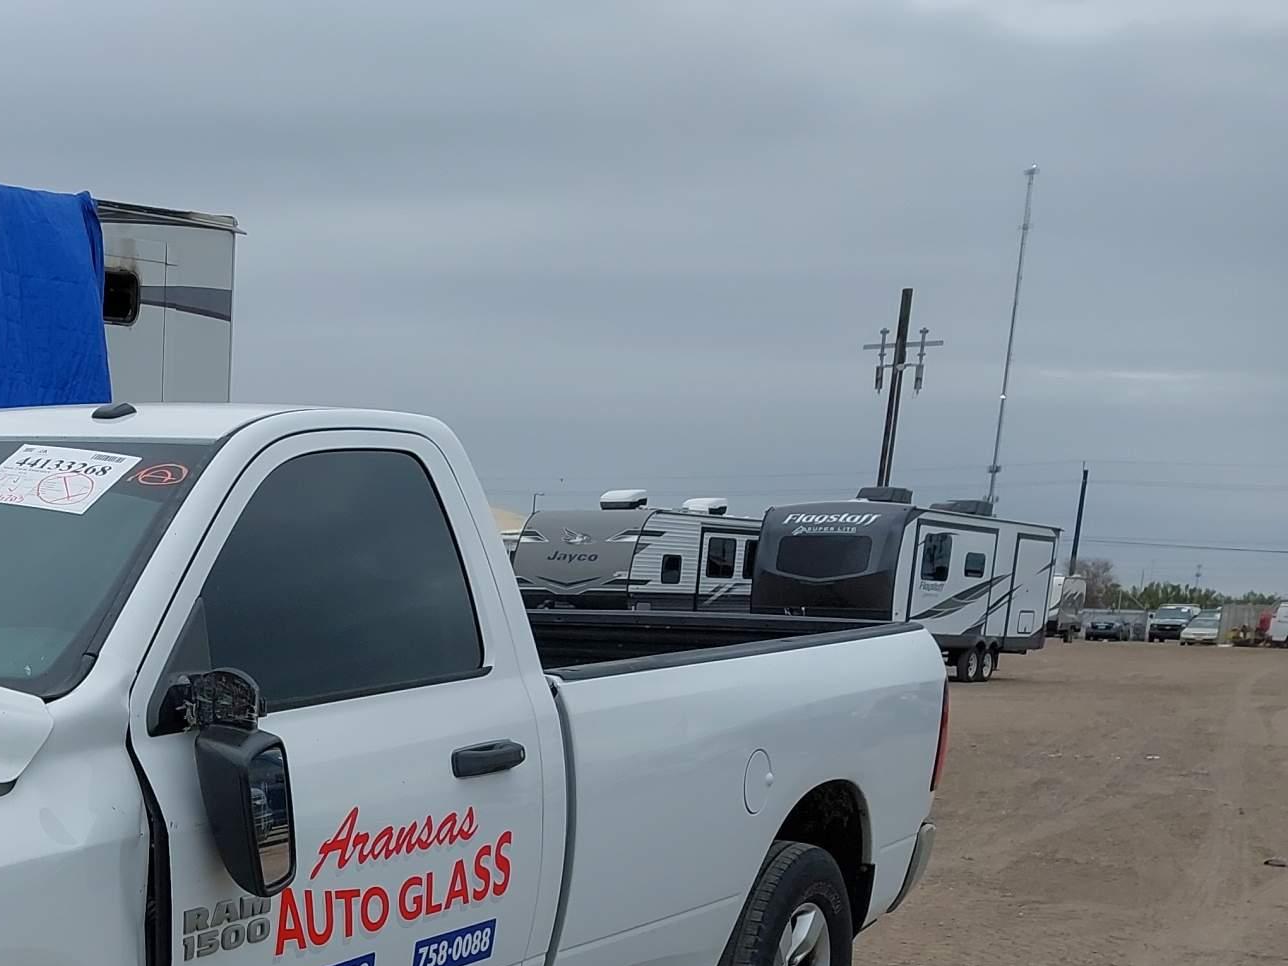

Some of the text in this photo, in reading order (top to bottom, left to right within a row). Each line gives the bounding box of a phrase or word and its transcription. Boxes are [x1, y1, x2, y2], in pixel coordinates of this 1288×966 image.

[15, 456, 112, 477] 44133268
[782, 512, 882, 526] Flagstaff
[547, 550, 599, 563] Jayco
[310, 806, 479, 880] Aransas
[274, 830, 513, 957] AUTO GLASS
[183, 895, 272, 935] RAM
[182, 917, 271, 962] 1500
